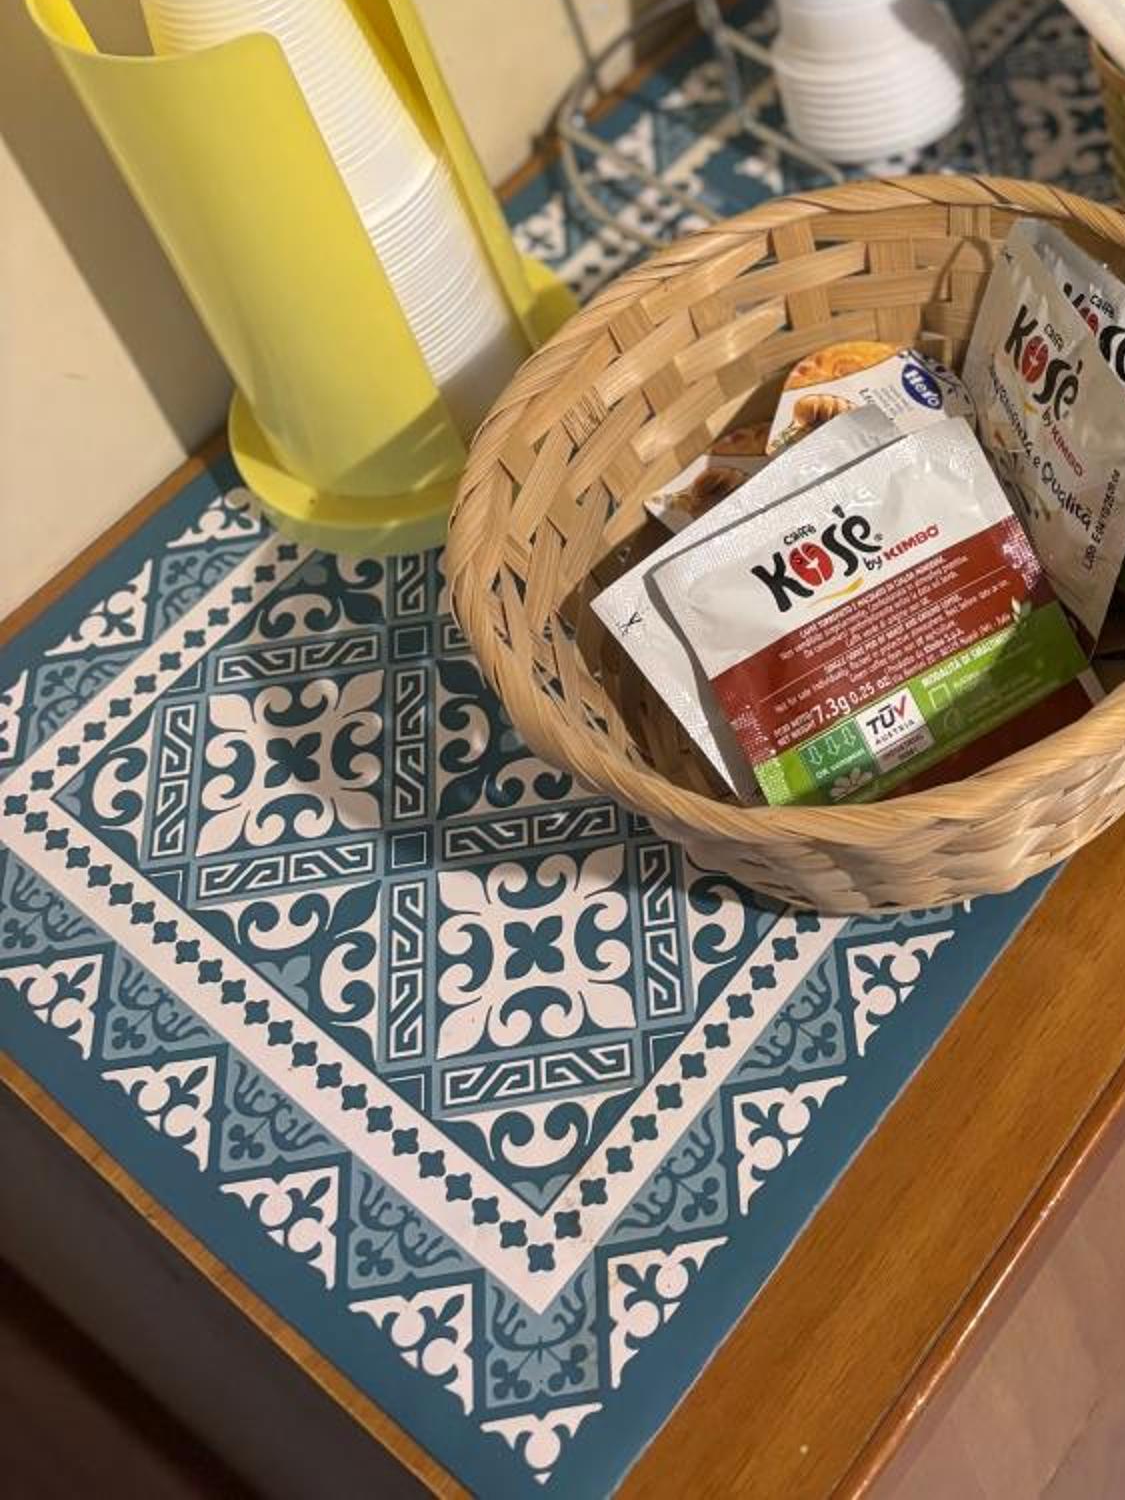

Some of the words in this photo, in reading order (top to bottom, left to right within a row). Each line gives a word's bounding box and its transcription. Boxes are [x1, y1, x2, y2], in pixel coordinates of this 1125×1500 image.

[903, 369, 940, 407] Hero
[1051, 423, 1085, 479] KIMBO
[862, 556, 884, 572] by
[883, 524, 940, 561] KIMBO
[814, 695, 851, 722] 7.3g
[850, 682, 876, 705] 0.25
[878, 675, 891, 689] oz
